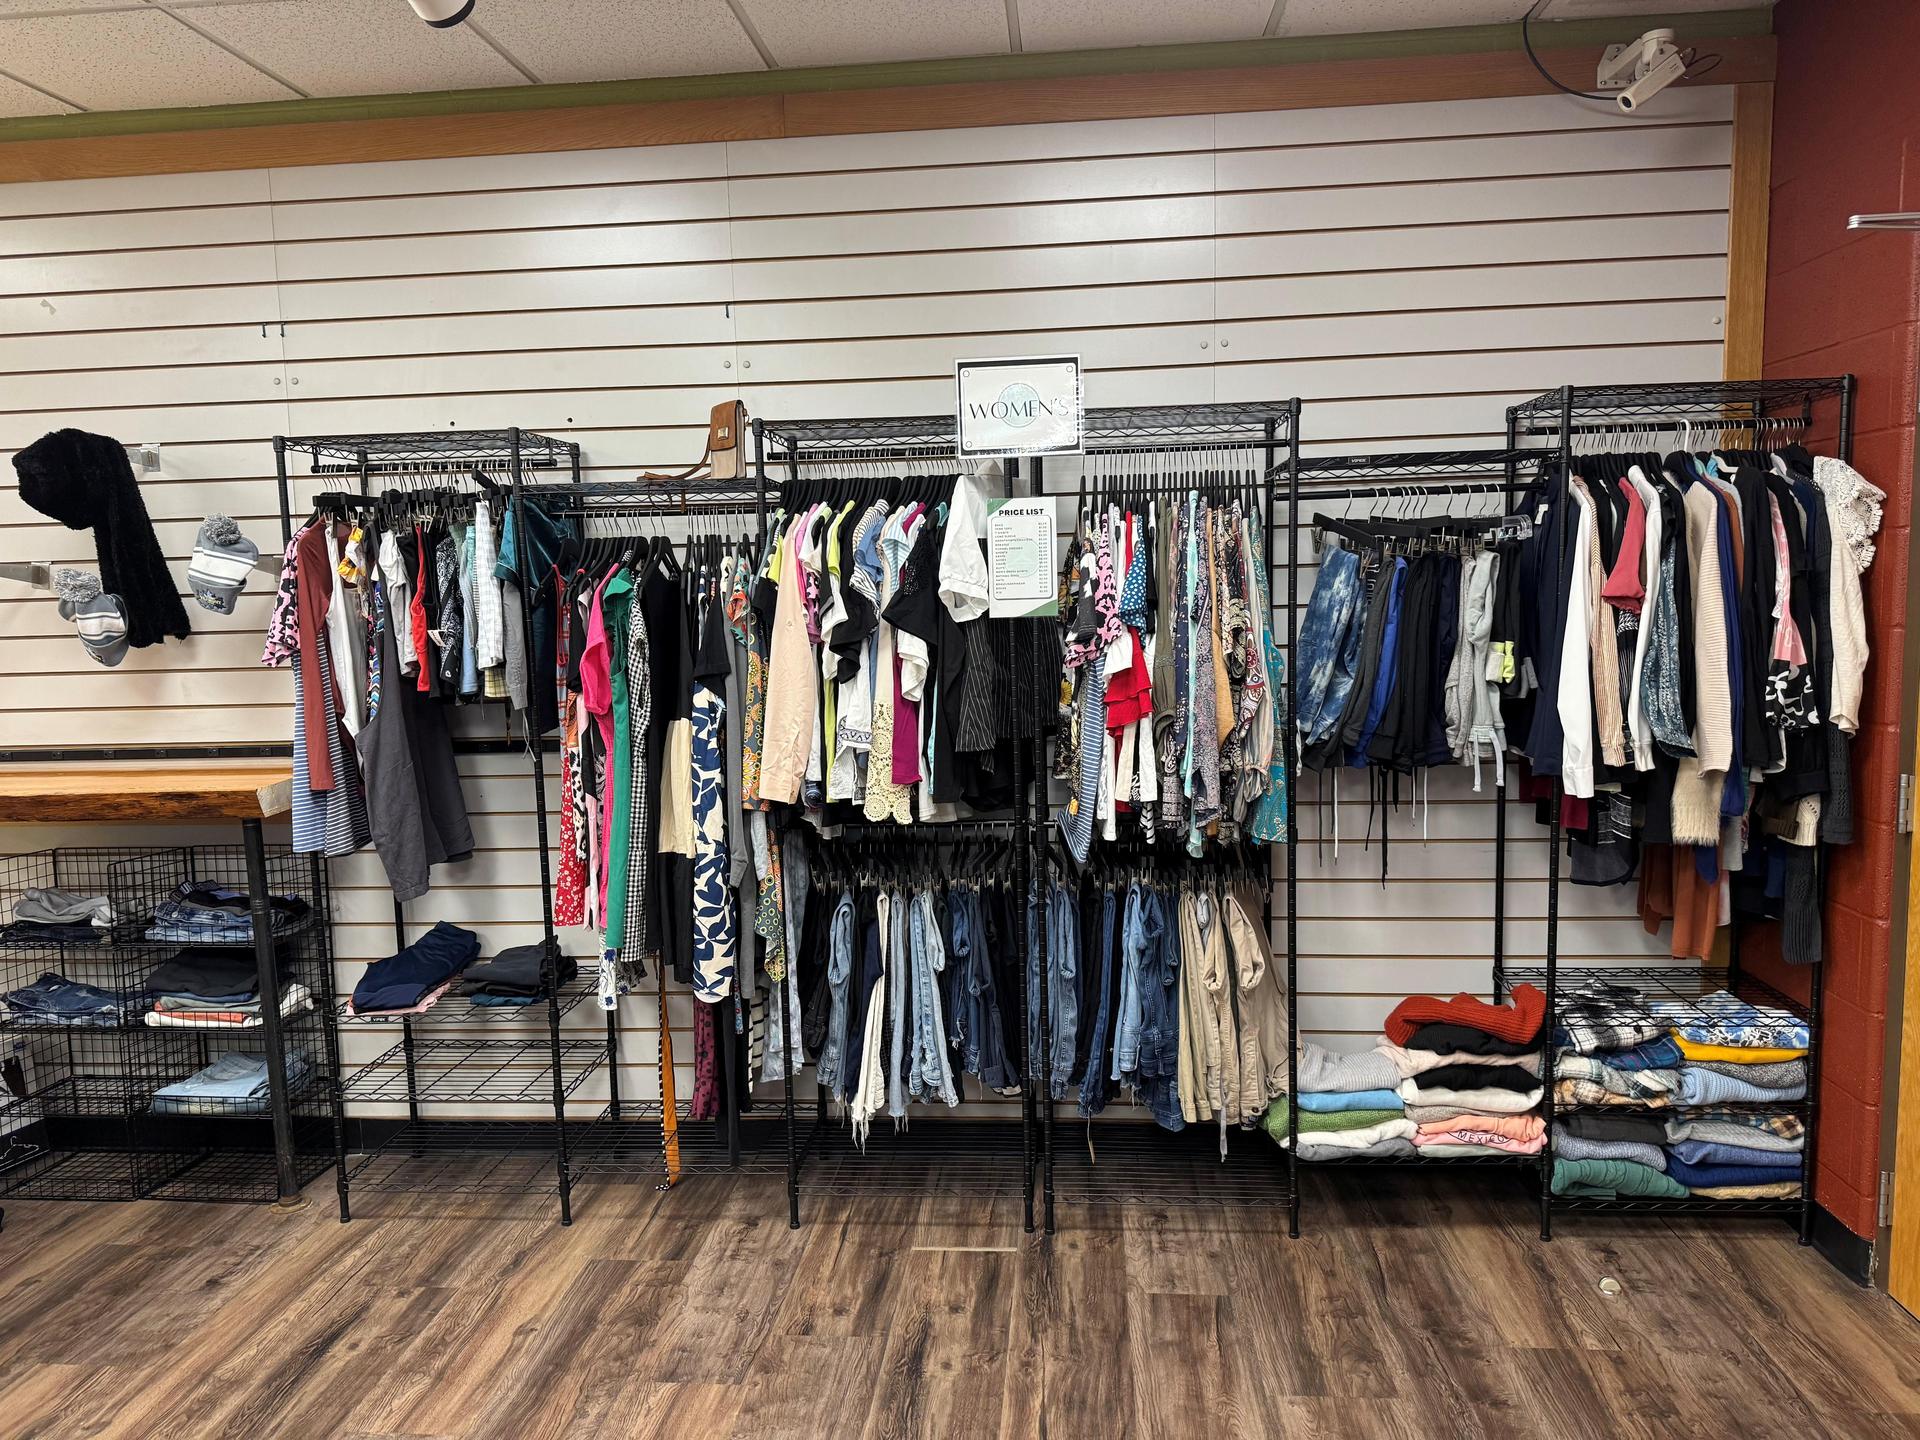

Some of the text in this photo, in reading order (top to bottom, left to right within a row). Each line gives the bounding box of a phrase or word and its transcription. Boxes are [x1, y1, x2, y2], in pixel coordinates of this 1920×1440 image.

[969, 398, 1069, 419] WOMEN'S
[1026, 508, 1045, 516] LIST
[1457, 1131, 1505, 1144] MEXICO
